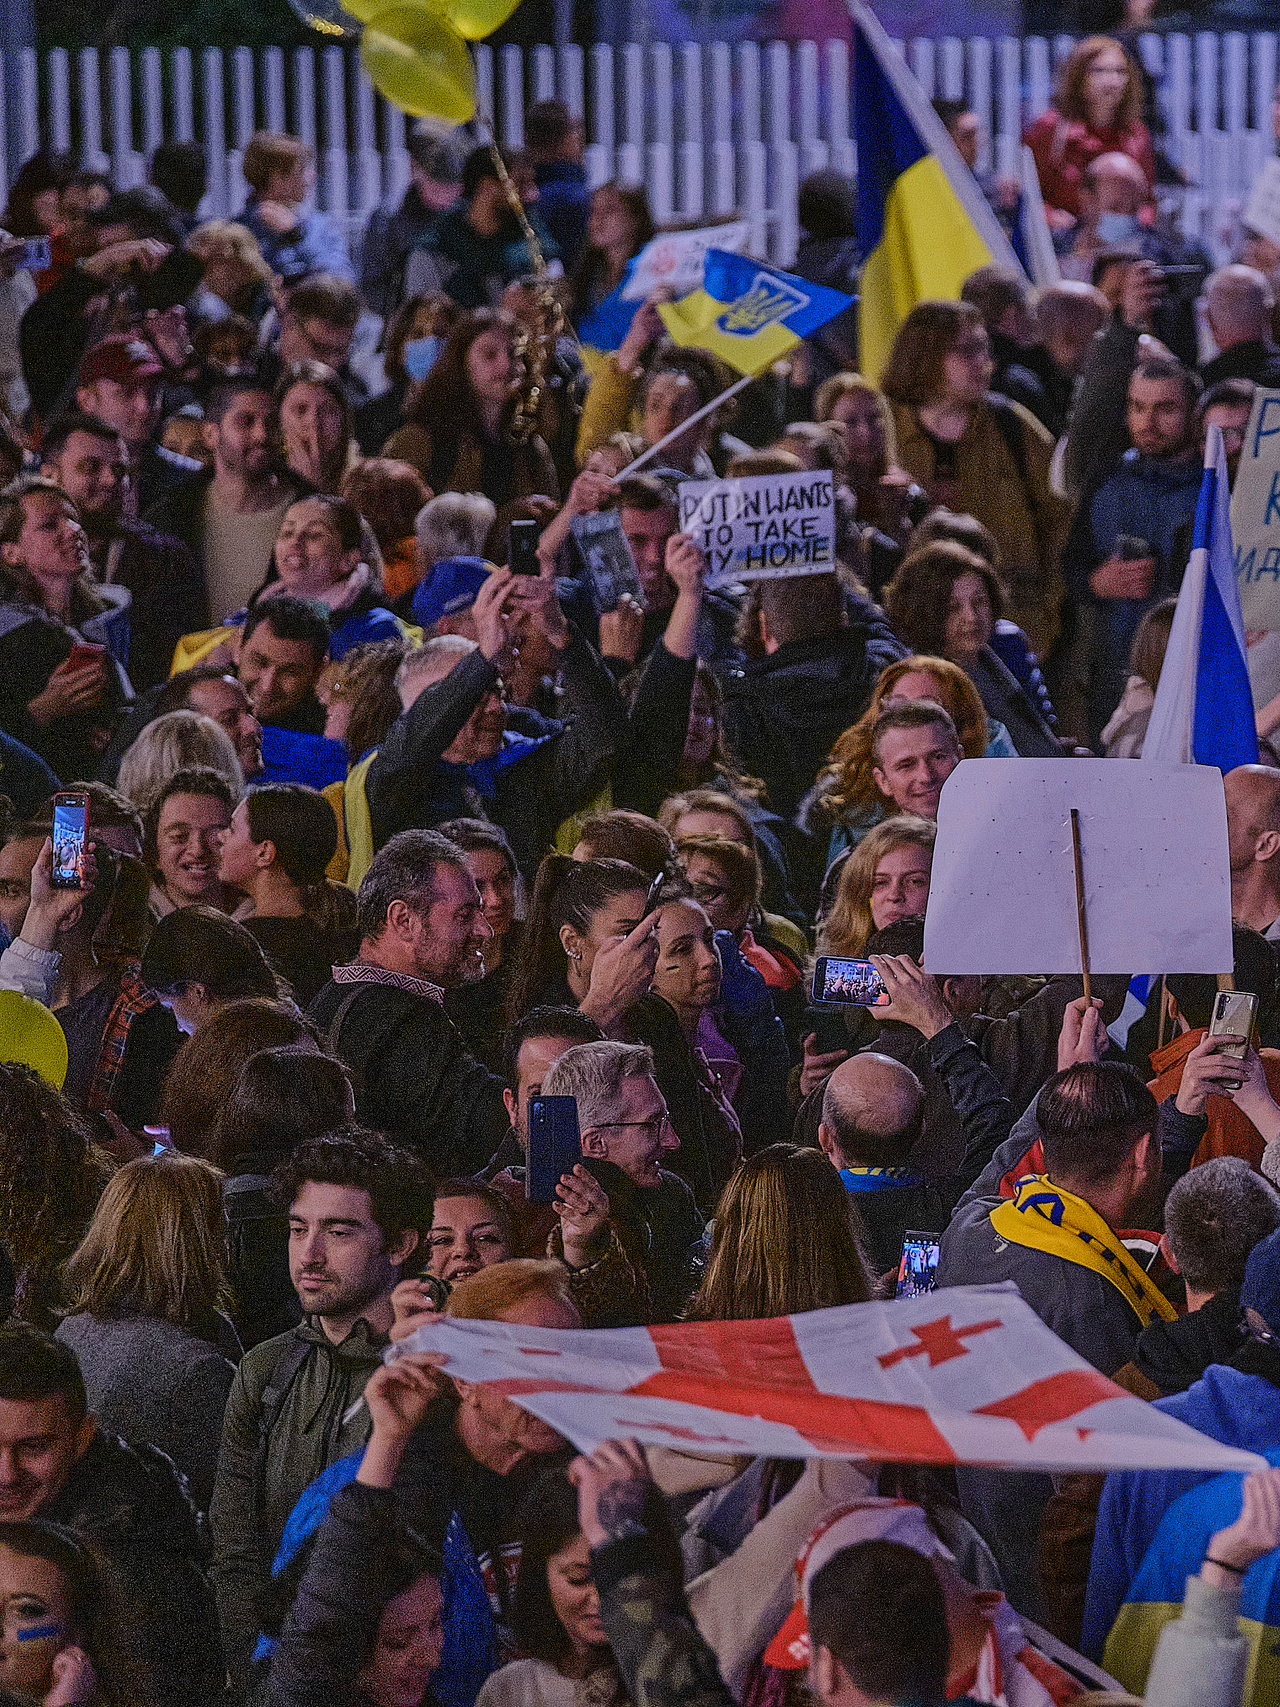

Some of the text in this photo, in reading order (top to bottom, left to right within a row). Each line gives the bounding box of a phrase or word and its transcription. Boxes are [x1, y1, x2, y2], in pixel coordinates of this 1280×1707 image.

[765, 480, 833, 515] WANTS
[745, 516, 821, 544] TAKE
[745, 535, 830, 570] HOME
